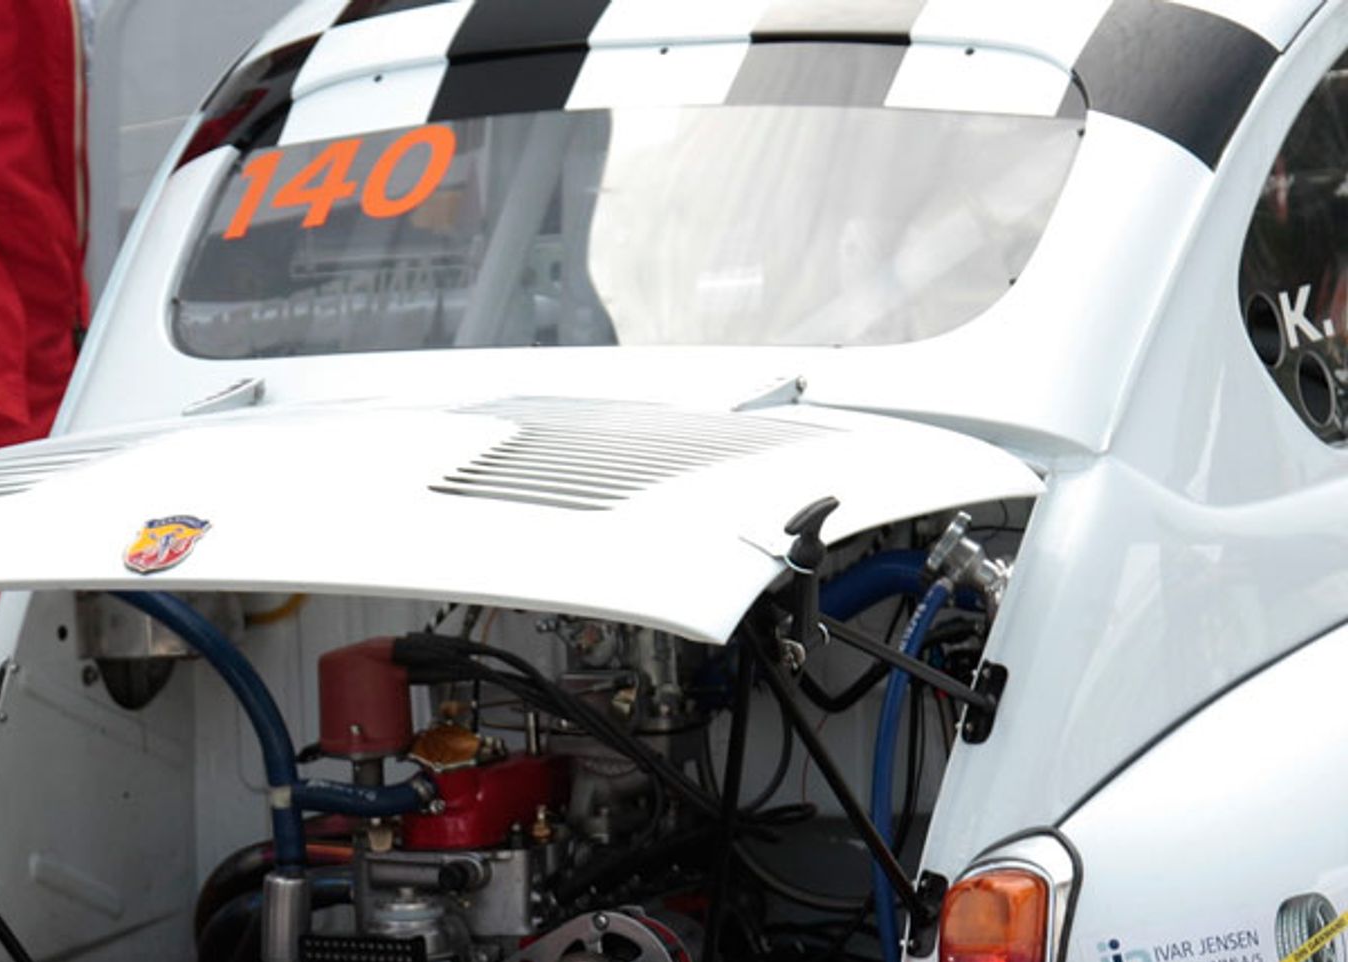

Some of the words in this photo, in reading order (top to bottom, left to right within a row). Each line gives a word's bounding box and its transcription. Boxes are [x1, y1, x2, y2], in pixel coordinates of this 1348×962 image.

[222, 125, 456, 240] 140
[1154, 941, 1193, 962] IVAR
[1198, 930, 1259, 956] JENSEN
